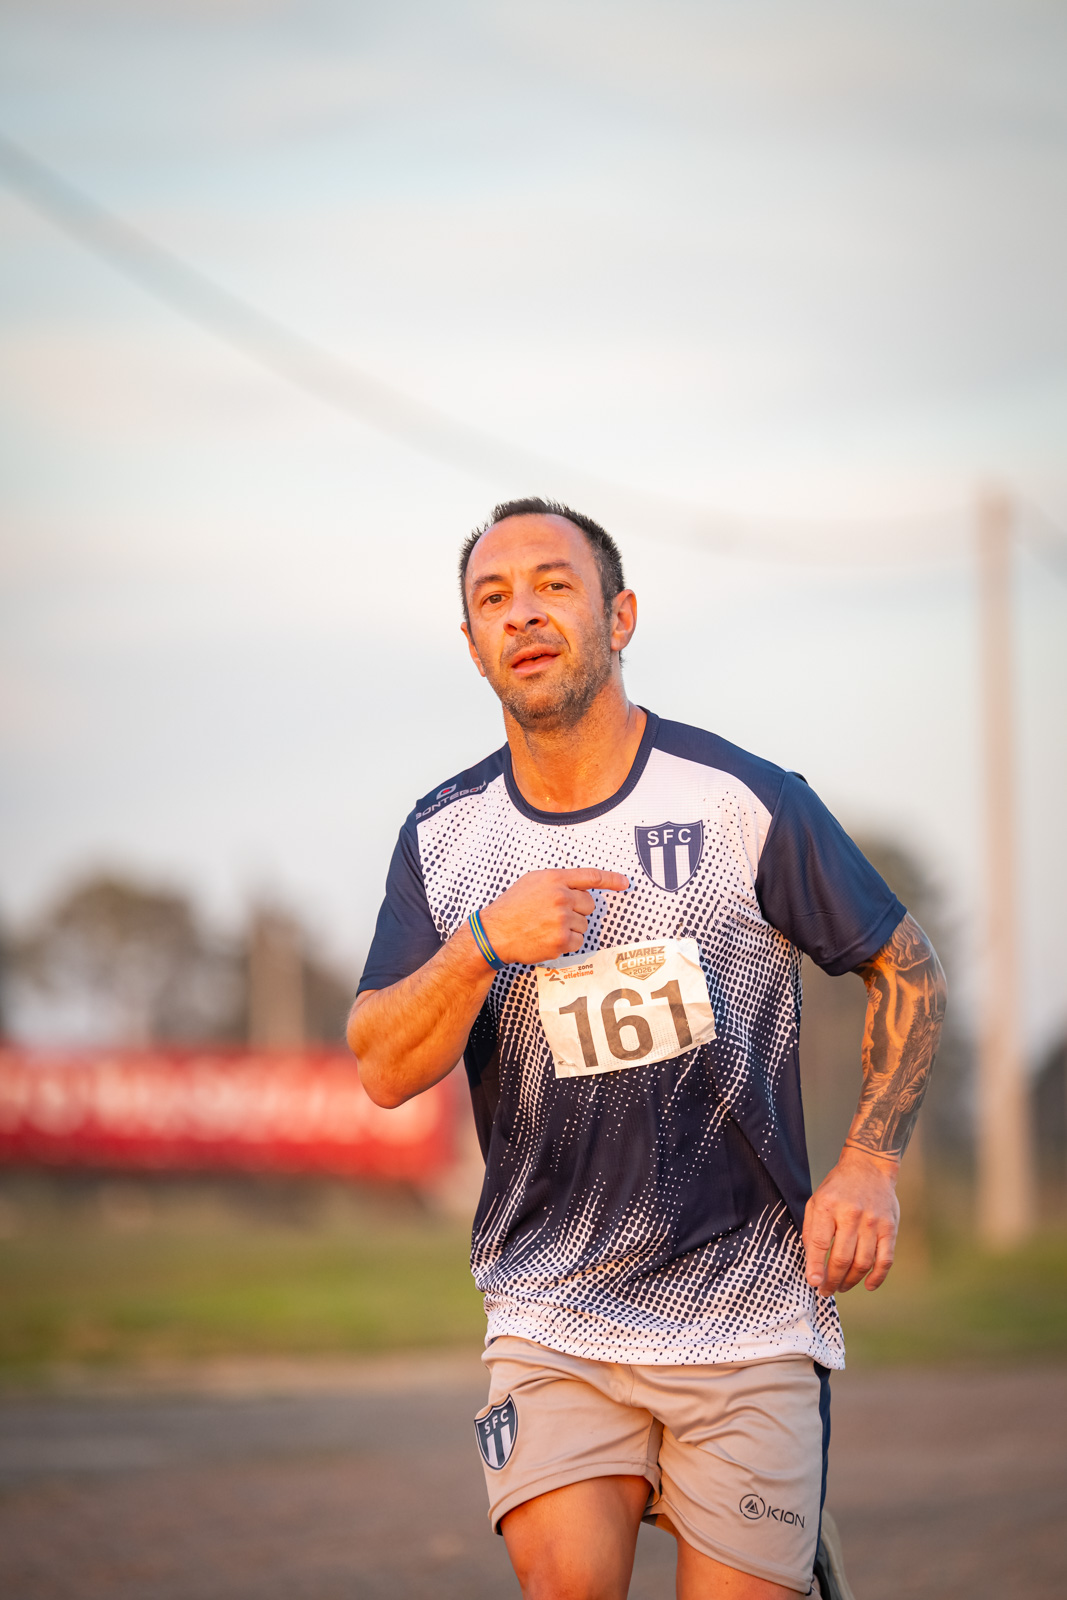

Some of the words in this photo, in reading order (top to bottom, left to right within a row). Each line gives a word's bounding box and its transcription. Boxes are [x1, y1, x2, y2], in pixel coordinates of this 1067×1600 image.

[647, 828, 692, 846] SFC
[615, 945, 666, 964] ALVAREZ
[619, 954, 665, 971] CORRE
[563, 969, 594, 980] atletismo
[558, 979, 693, 1068] 161
[484, 1408, 509, 1435] SFC
[766, 1505, 805, 1529] KION
